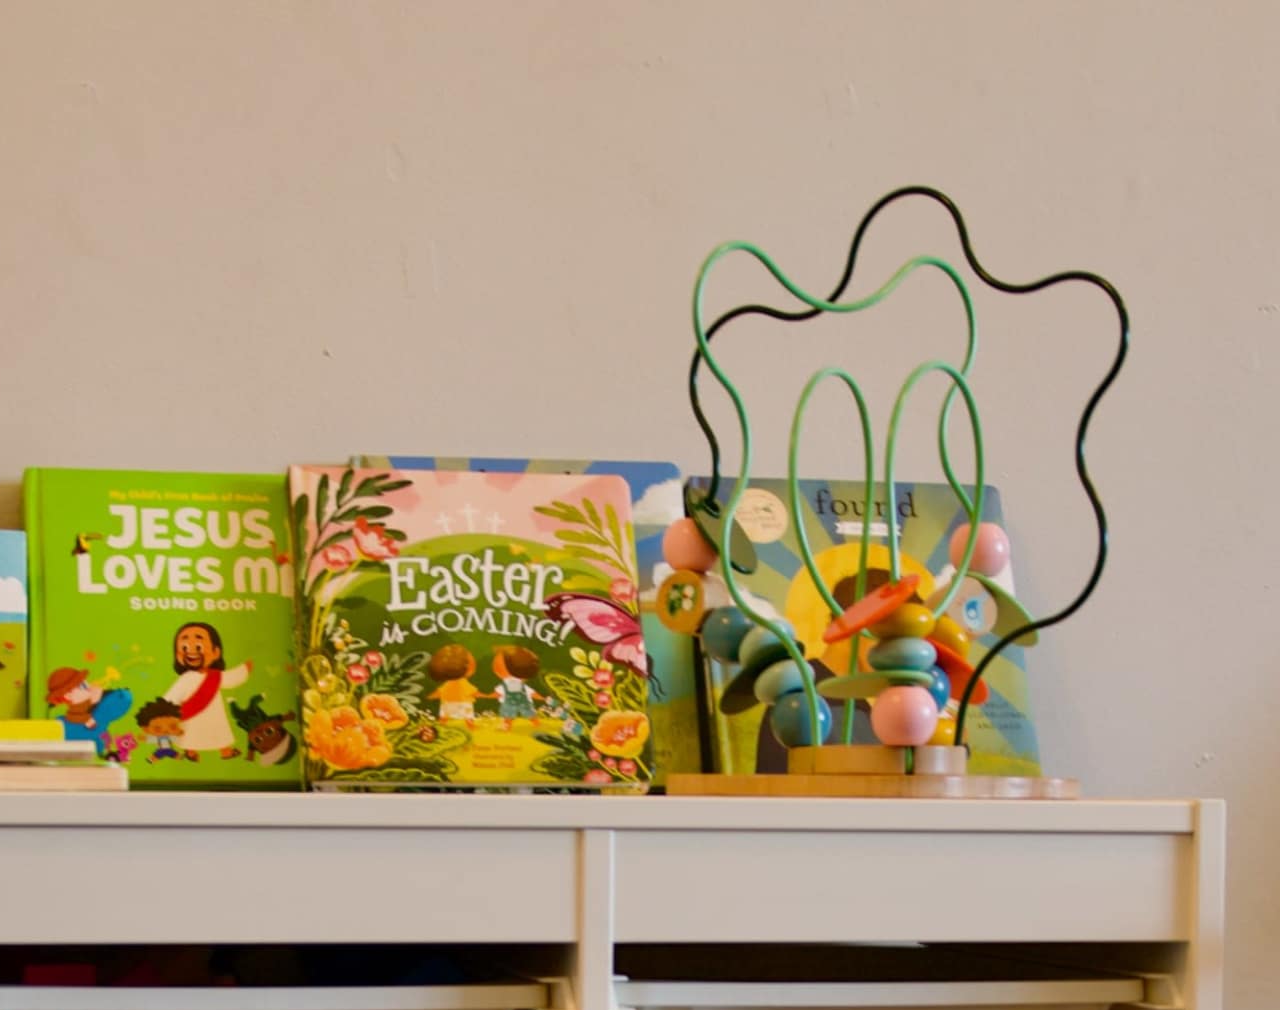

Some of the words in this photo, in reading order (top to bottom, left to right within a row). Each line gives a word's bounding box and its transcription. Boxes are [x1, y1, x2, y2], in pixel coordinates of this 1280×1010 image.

[107, 504, 275, 549] JESUS
[77, 553, 224, 594] LOVES
[384, 548, 564, 612] Easter
[129, 596, 198, 611] SOUND
[204, 599, 257, 611] BOOK
[379, 619, 409, 647] is
[411, 606, 575, 648] COMING!
